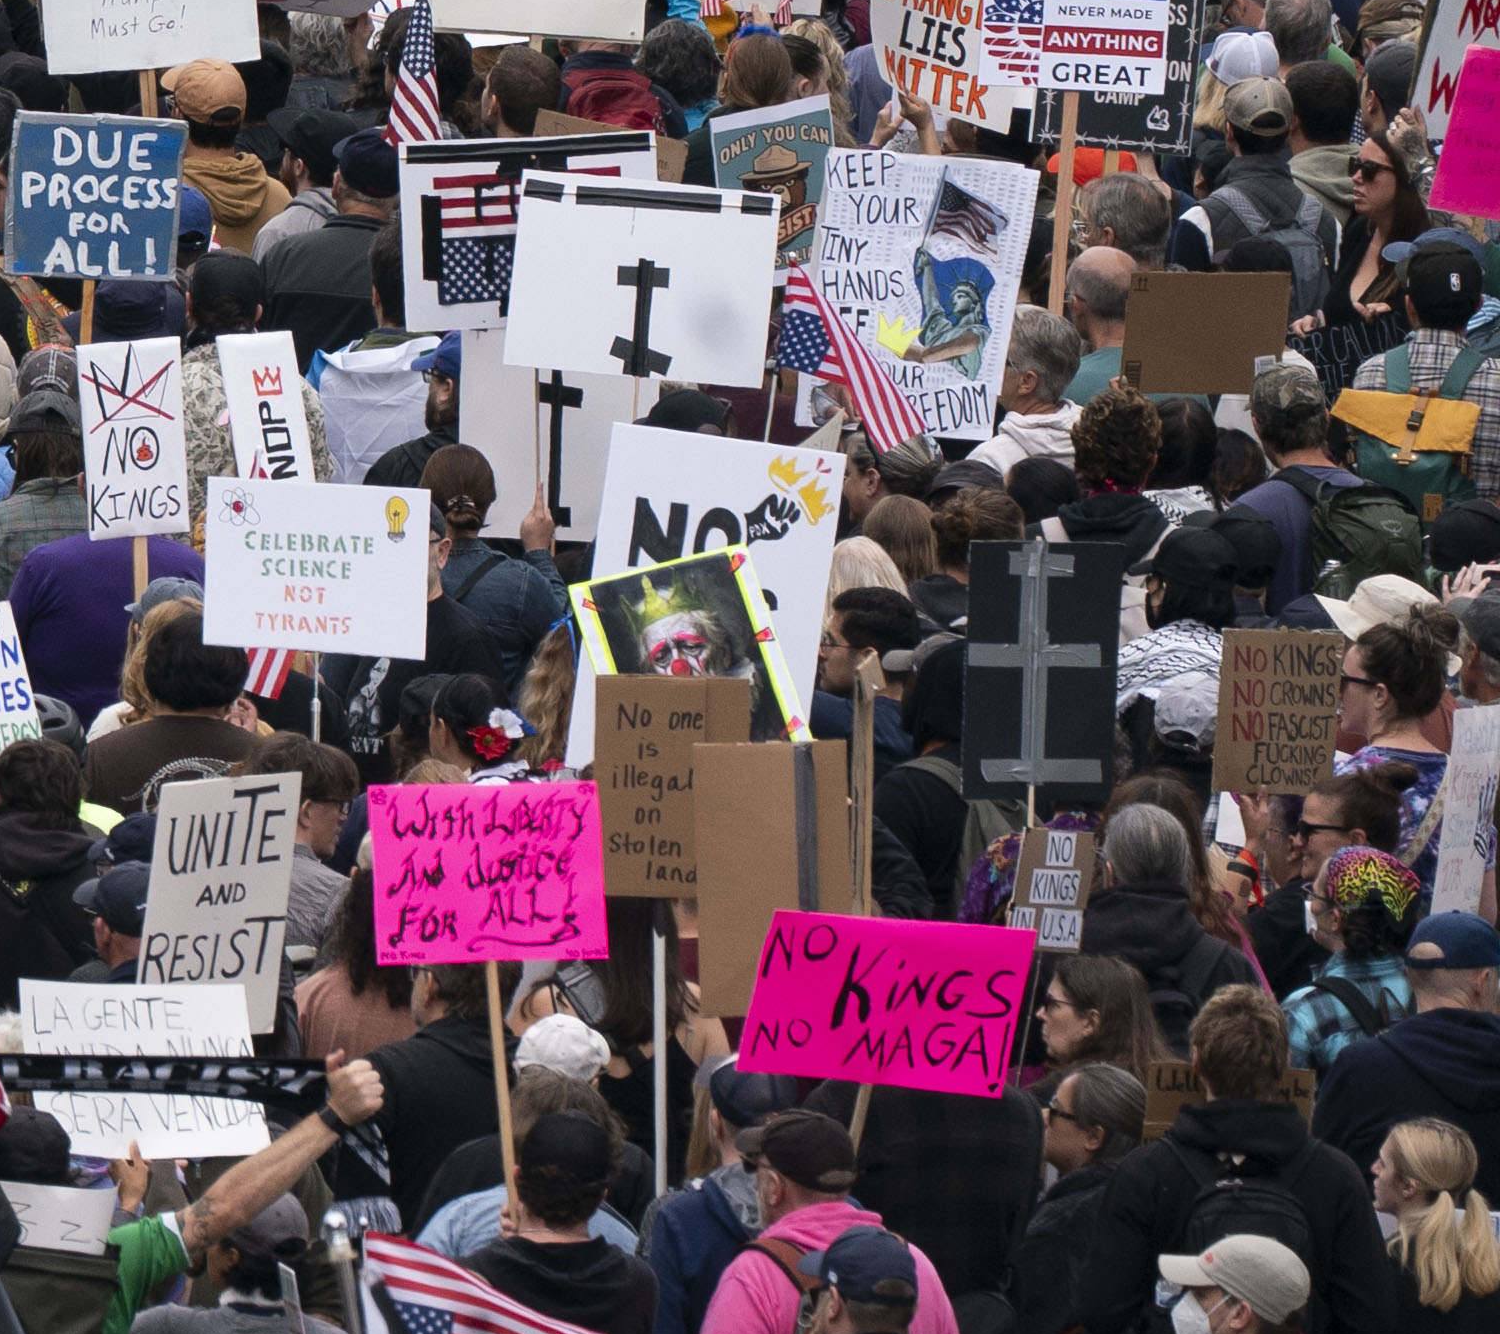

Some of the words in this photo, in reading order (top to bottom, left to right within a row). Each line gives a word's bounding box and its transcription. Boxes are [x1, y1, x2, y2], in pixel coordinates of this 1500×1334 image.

[1057, 5, 1101, 20] NEVER
[1109, 5, 1153, 20] MADE
[1045, 29, 1160, 55] ANYTHING
[1051, 62, 1150, 88] GREAT
[52, 126, 153, 172] DUE
[21, 172, 177, 212] PROCESS
[820, 265, 905, 300] HANDS
[90, 484, 181, 531] KINGS
[243, 529, 375, 556] CELEBRATE
[260, 556, 352, 579] SCIENCE
[254, 611, 352, 636] TYRANTS
[1234, 645, 1268, 673] NO
[1272, 643, 1338, 677] KINGS
[1233, 679, 1266, 707] NO
[1269, 680, 1336, 707] CROWNS
[169, 783, 286, 876] UNITE
[139, 916, 286, 985] RESIST
[762, 921, 838, 979] NO
[754, 1017, 812, 1056] NO
[842, 1019, 1016, 1094] MAGA!
